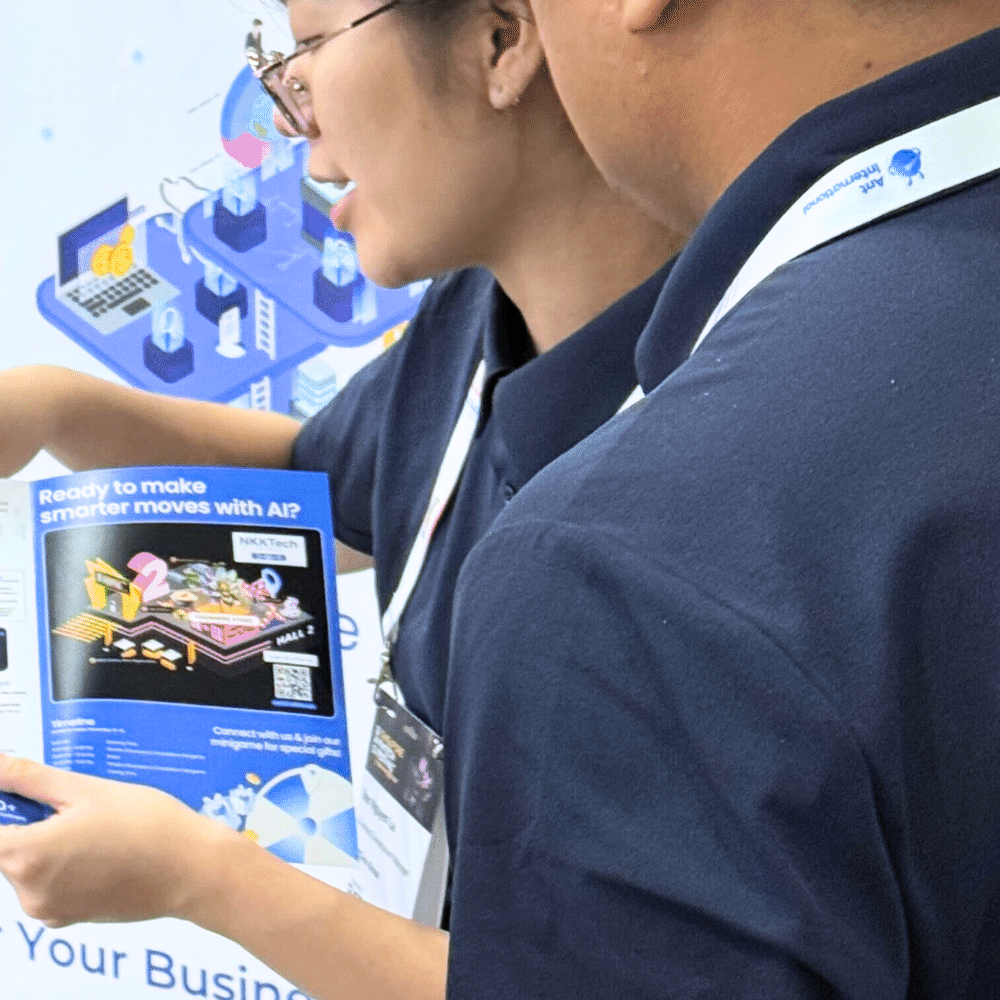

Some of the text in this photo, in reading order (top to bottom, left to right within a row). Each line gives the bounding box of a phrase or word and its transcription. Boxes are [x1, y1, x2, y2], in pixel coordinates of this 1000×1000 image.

[859, 176, 884, 194] Ant
[39, 477, 207, 505] Ready to make
[40, 498, 301, 524] smarter moves with AI?
[16, 920, 128, 979] Your
